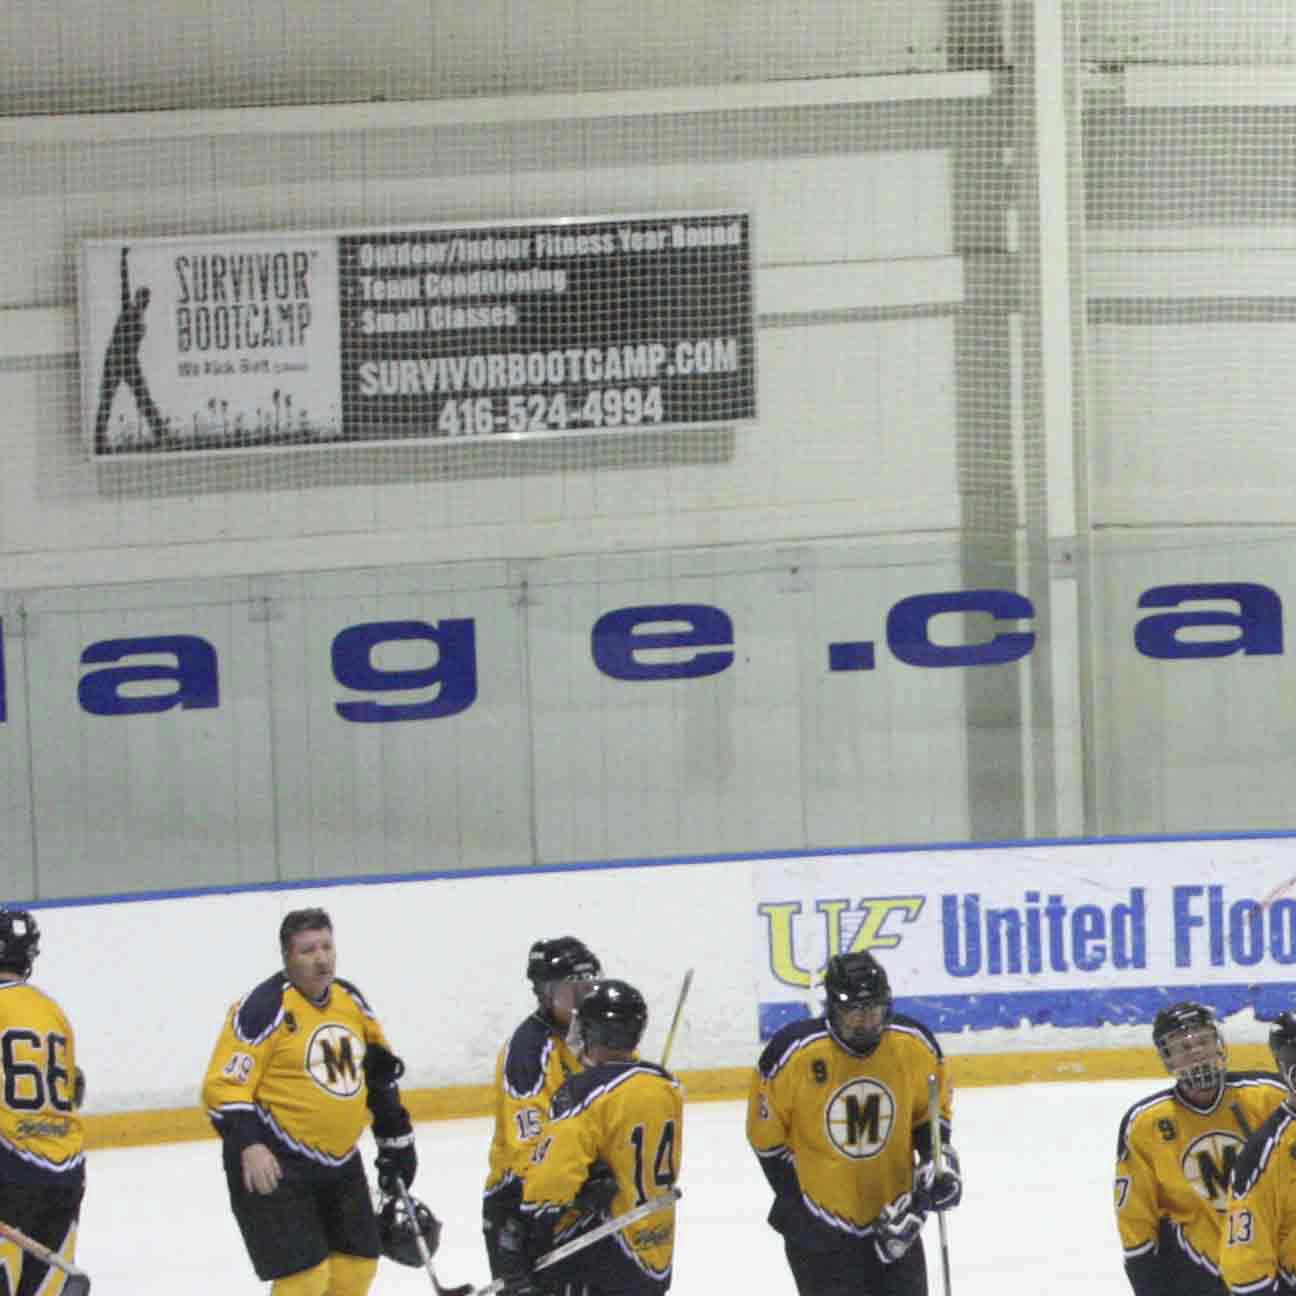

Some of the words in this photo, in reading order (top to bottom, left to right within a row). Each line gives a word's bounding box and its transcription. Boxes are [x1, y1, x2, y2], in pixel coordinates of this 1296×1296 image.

[175, 251, 311, 304] SURVIVOR
[361, 275, 421, 301] Team
[176, 302, 312, 352] BOOTCAMP
[362, 306, 425, 335] Small
[360, 338, 737, 396] SURVIVORBOOTCAMP.COM
[438, 387, 664, 436] 416-524-4994
[941, 886, 1146, 979] United
[319, 1037, 357, 1086] M
[844, 1094, 883, 1148] M
